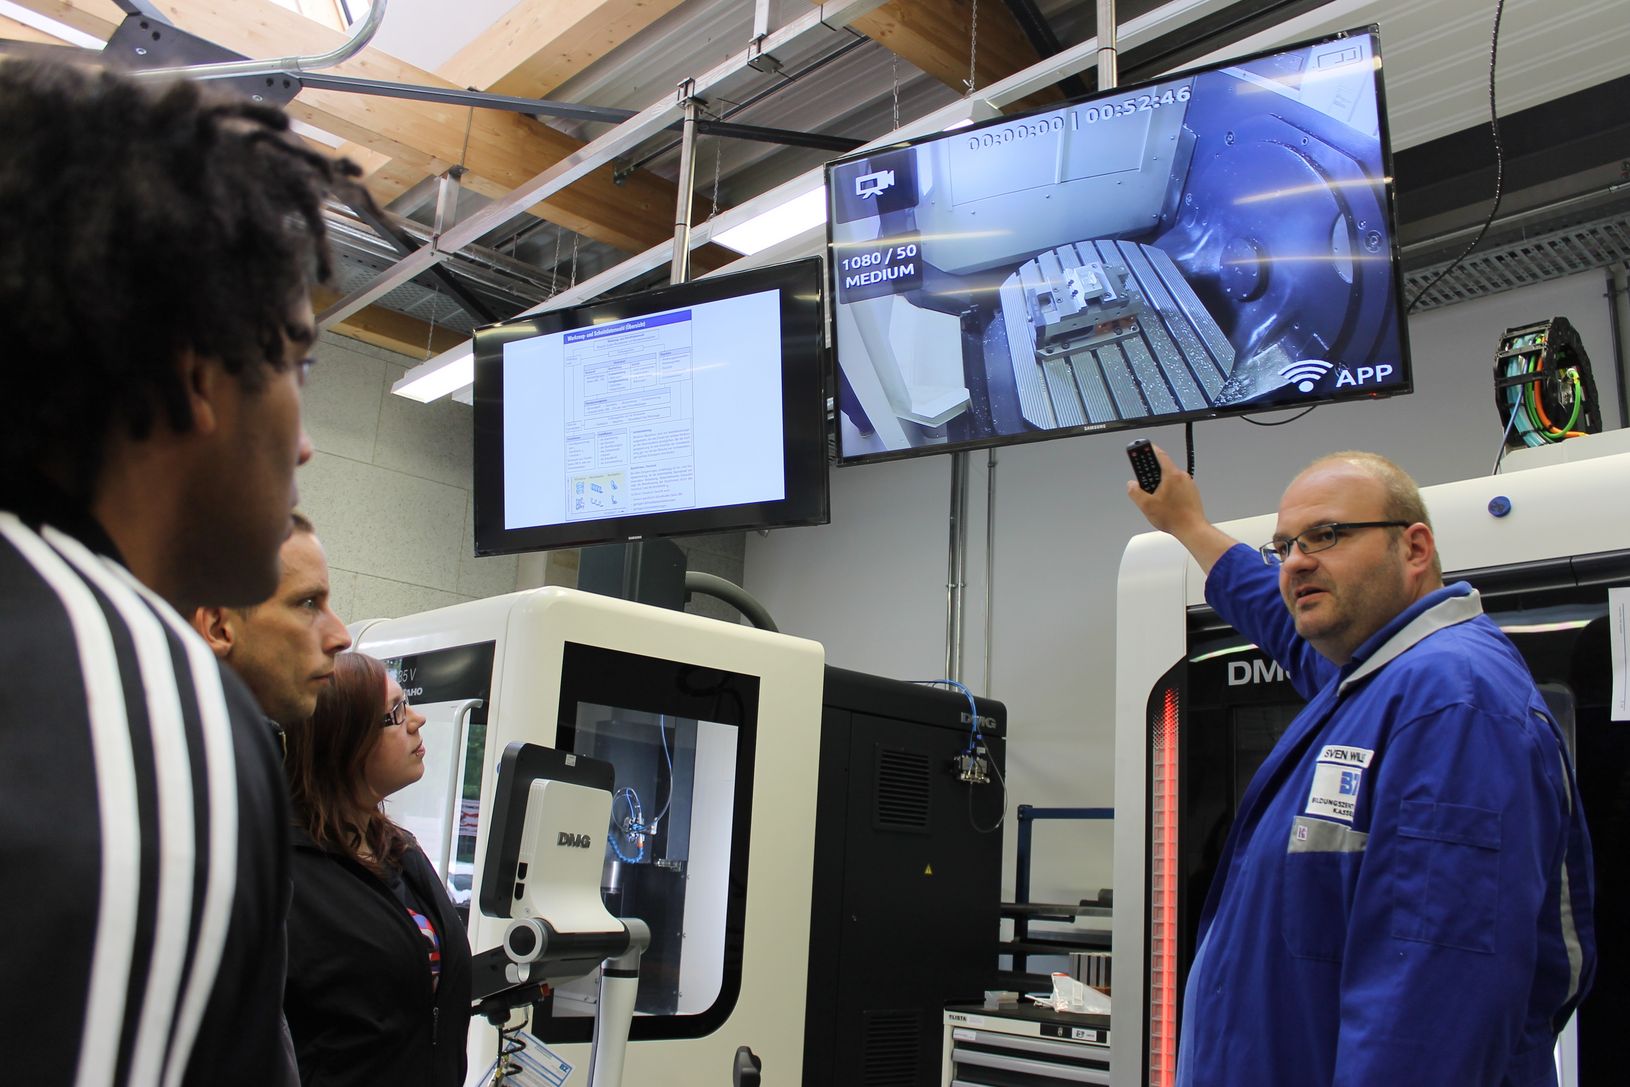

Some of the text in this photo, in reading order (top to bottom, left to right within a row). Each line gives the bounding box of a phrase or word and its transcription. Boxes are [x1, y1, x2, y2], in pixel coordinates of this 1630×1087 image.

[968, 116, 1065, 151] 00:00:00
[1086, 86, 1192, 124] 00:52:46
[842, 252, 881, 271] 1080
[896, 244, 917, 260] 50
[845, 263, 915, 289] MEDIUM
[1335, 364, 1393, 388] APP
[1084, 423, 1106, 431] SAMSUNG
[410, 667, 417, 681] V
[1228, 659, 1291, 686] DM
[1324, 749, 1347, 760] SVEN
[557, 831, 591, 849] DMG
